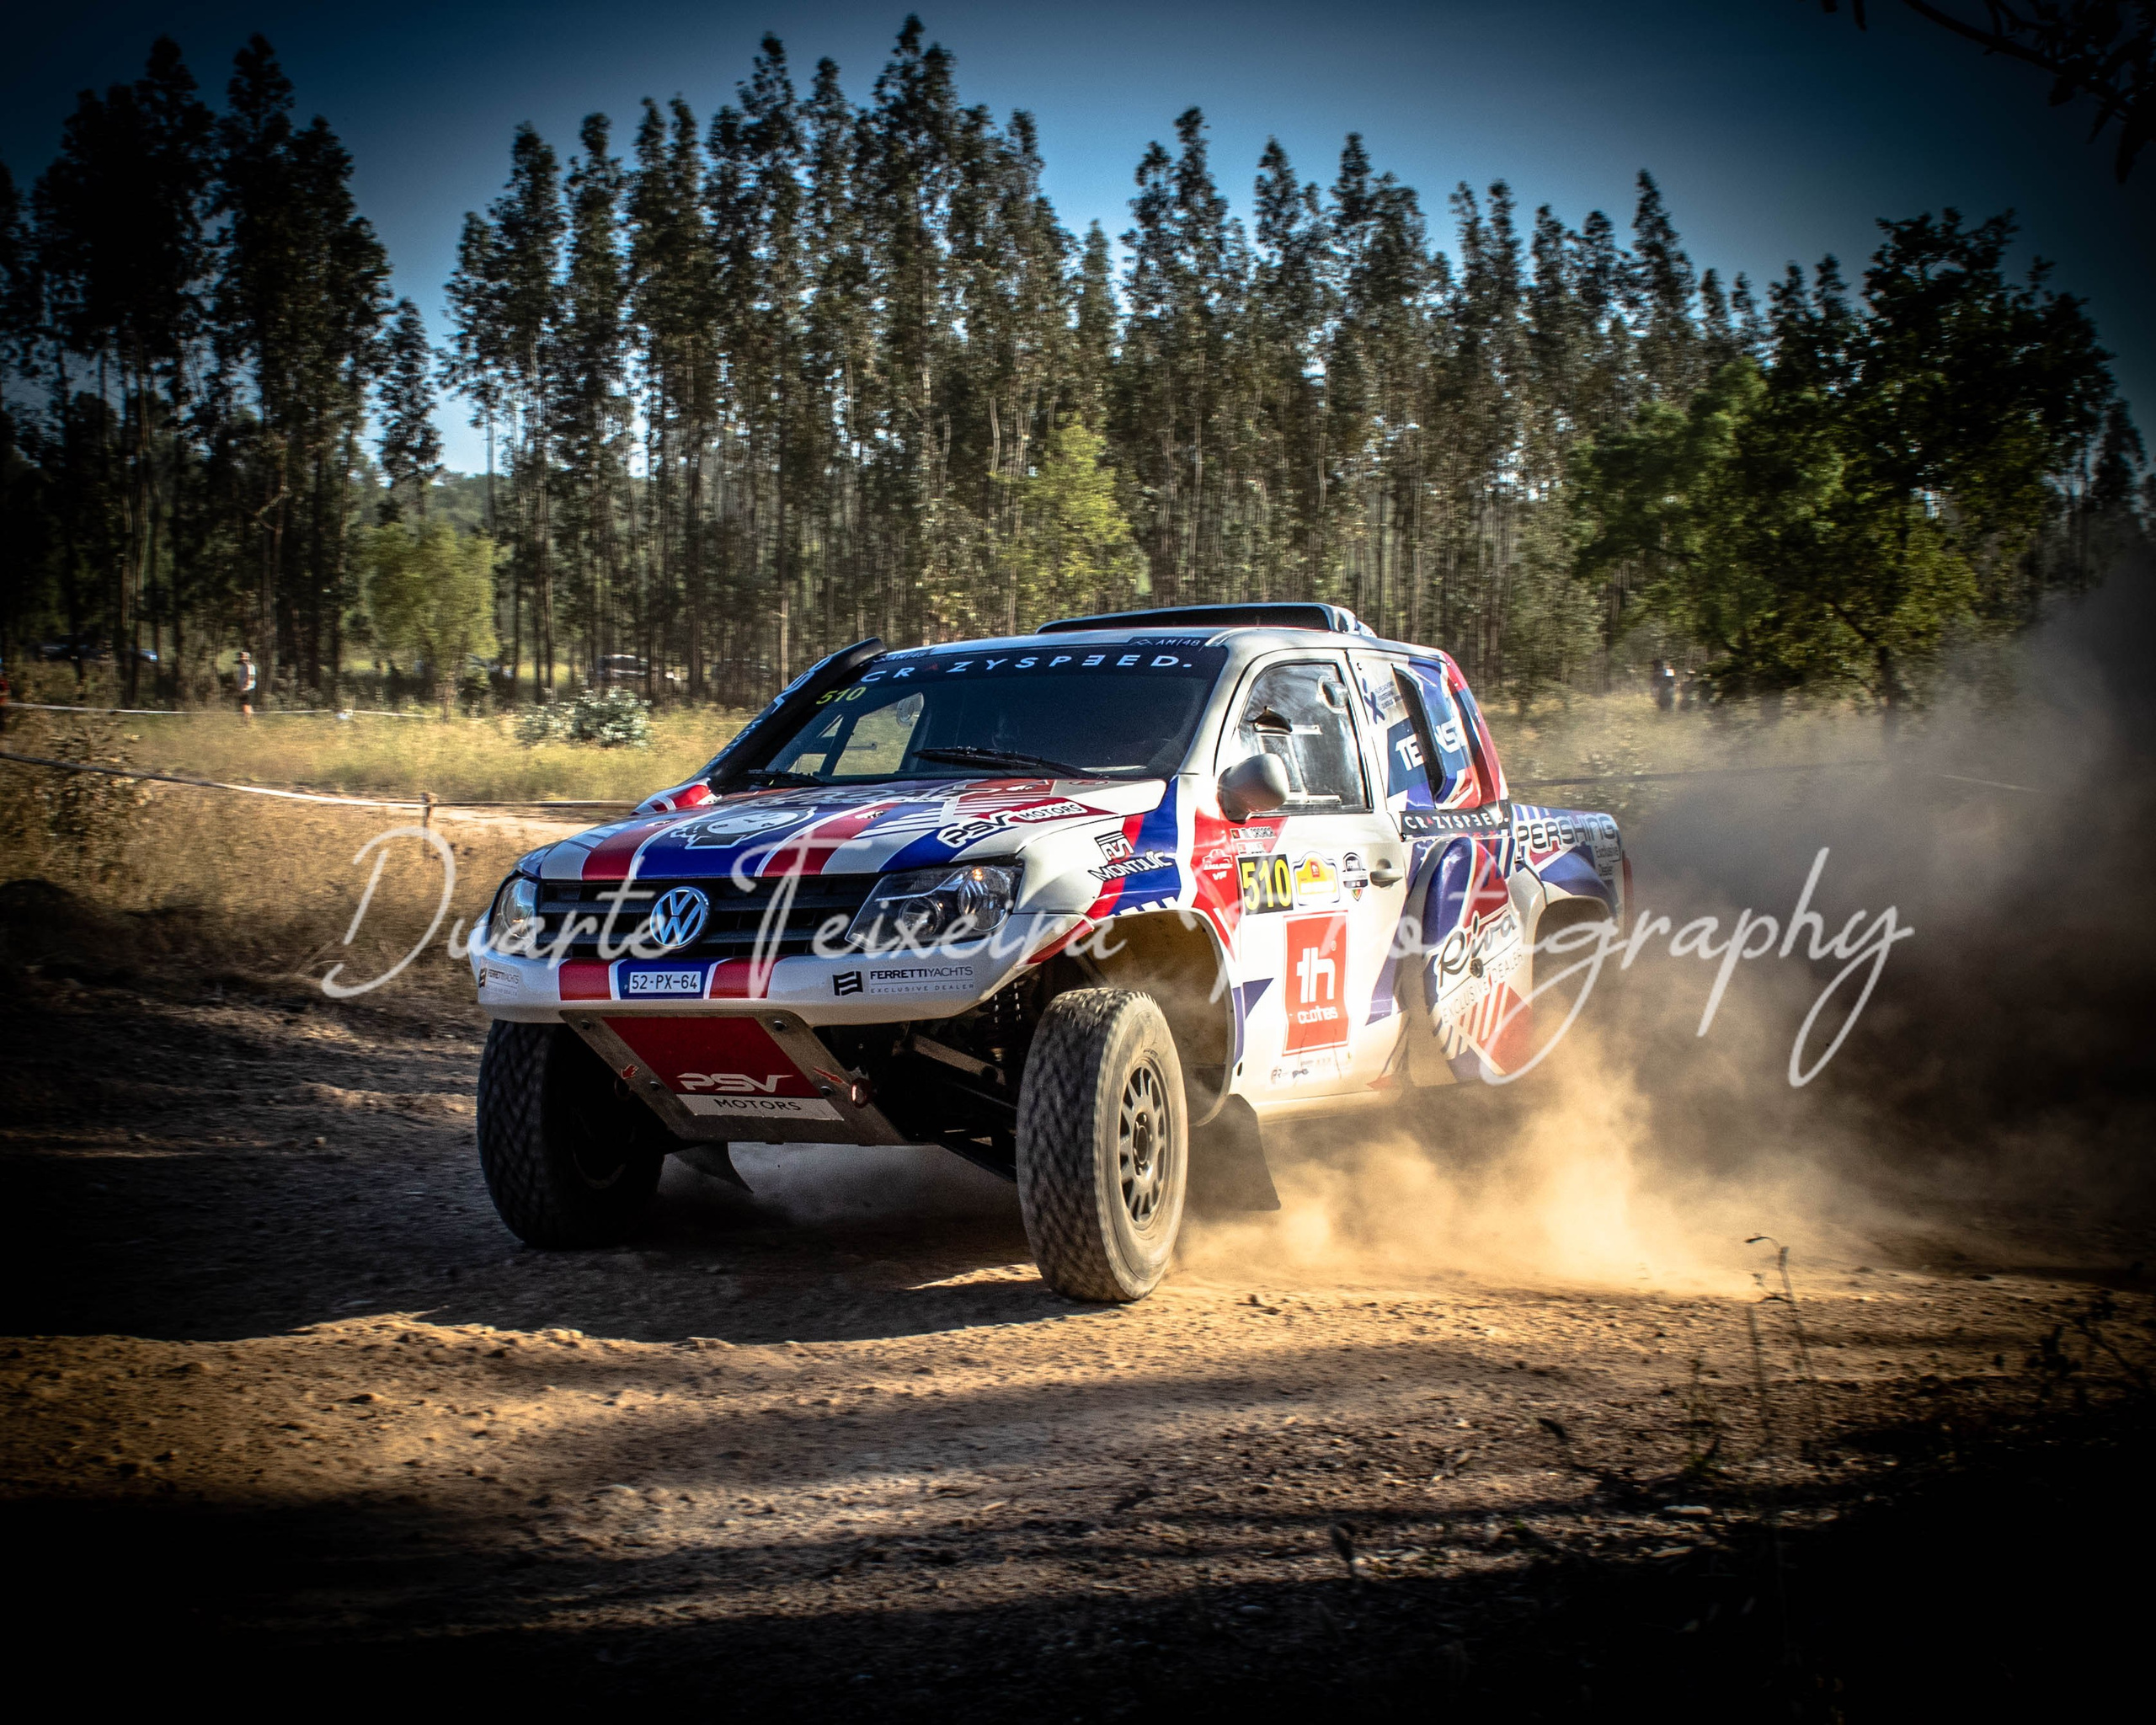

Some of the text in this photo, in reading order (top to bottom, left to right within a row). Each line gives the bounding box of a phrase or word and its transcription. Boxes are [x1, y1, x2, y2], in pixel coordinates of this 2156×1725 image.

[816, 686, 866, 704] 510
[1020, 804, 1082, 820] MOTORS
[1241, 859, 1292, 911] 510
[1437, 914, 1517, 987] Riva
[1296, 947, 1336, 1004] th
[677, 1072, 794, 1093] PSV
[713, 1098, 802, 1112] MOTORS
